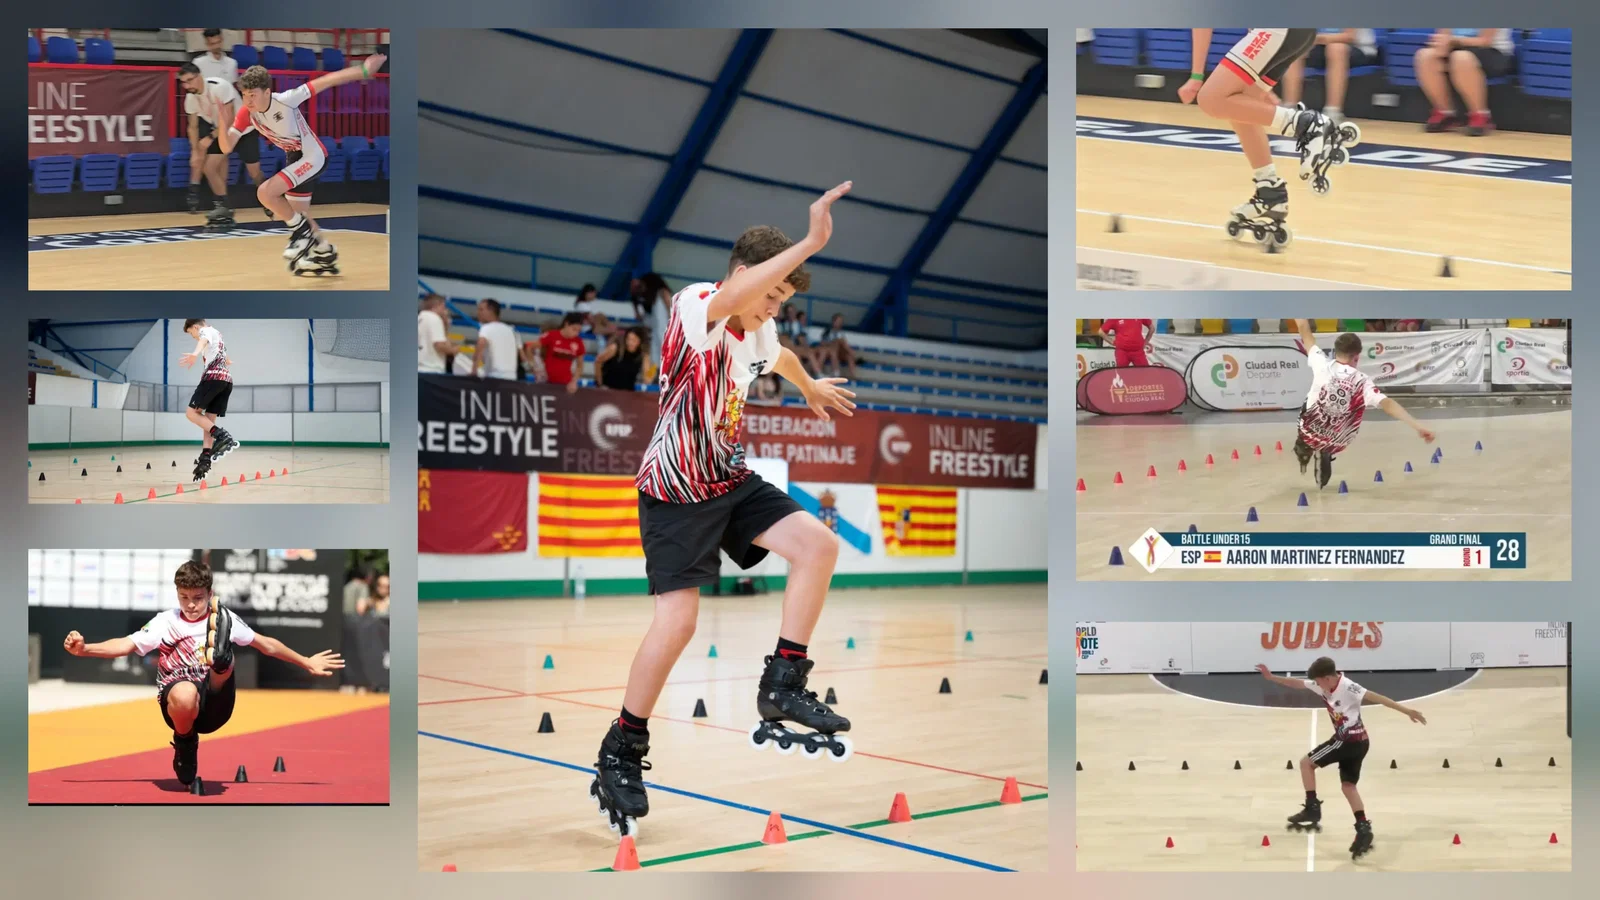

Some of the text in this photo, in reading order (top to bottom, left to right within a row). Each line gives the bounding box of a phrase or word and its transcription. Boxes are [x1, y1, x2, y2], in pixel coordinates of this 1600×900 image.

[1245, 361, 1300, 370] Ciudad Real
[1246, 371, 1281, 380] Deporte
[460, 389, 558, 425] INLINE
[929, 424, 995, 452] INLINE
[786, 443, 856, 465] PATINAJE
[929, 451, 1029, 478] FREESTYLE
[1261, 622, 1383, 649] JUDGES
